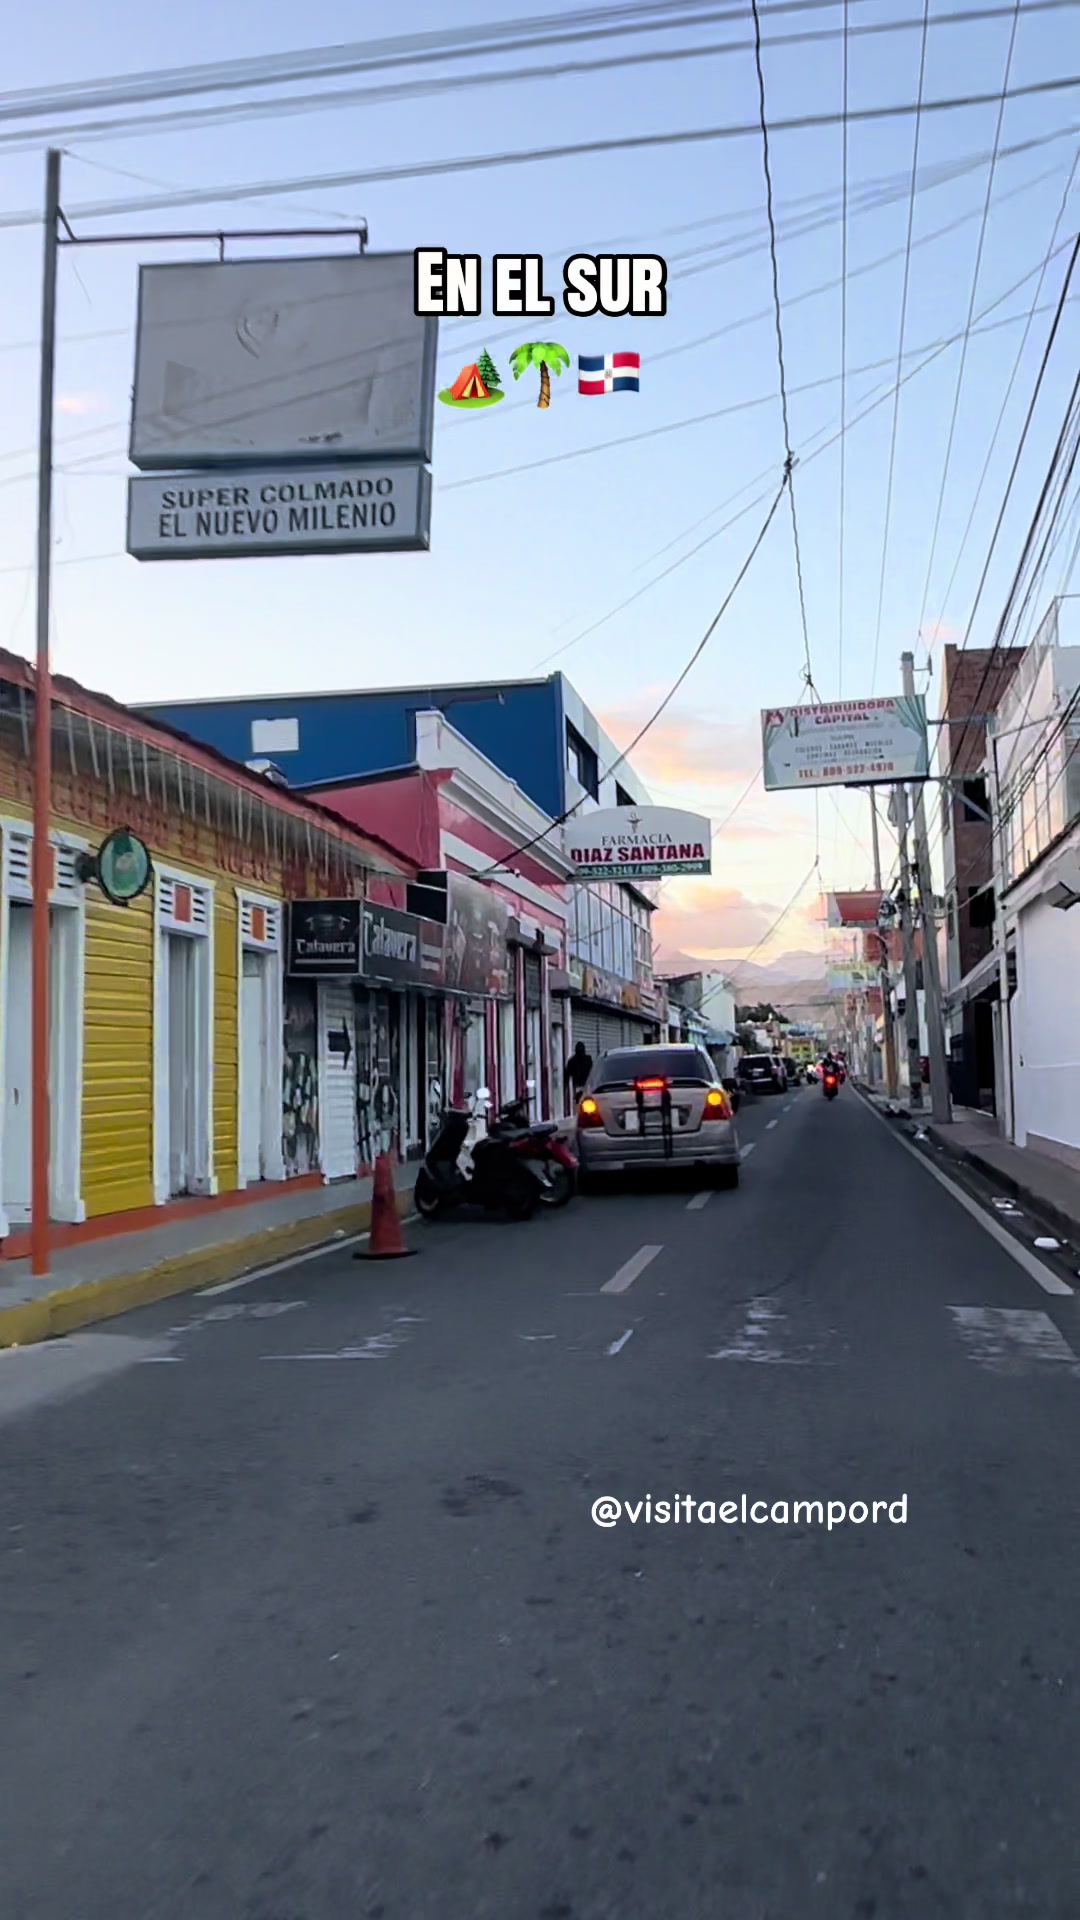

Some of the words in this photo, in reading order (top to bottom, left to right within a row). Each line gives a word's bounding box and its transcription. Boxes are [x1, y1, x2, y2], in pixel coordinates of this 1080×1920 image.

[162, 487, 249, 509] SUPER
[260, 477, 394, 505] COLMADO
[159, 512, 187, 538] EL
[195, 508, 278, 537] NUEVO
[288, 501, 397, 532] MILENIO
[814, 712, 870, 725] CAPITAL
[601, 833, 673, 847] FARMACIA
[570, 847, 614, 863] DIAZ
[618, 843, 705, 862] SANTANA
